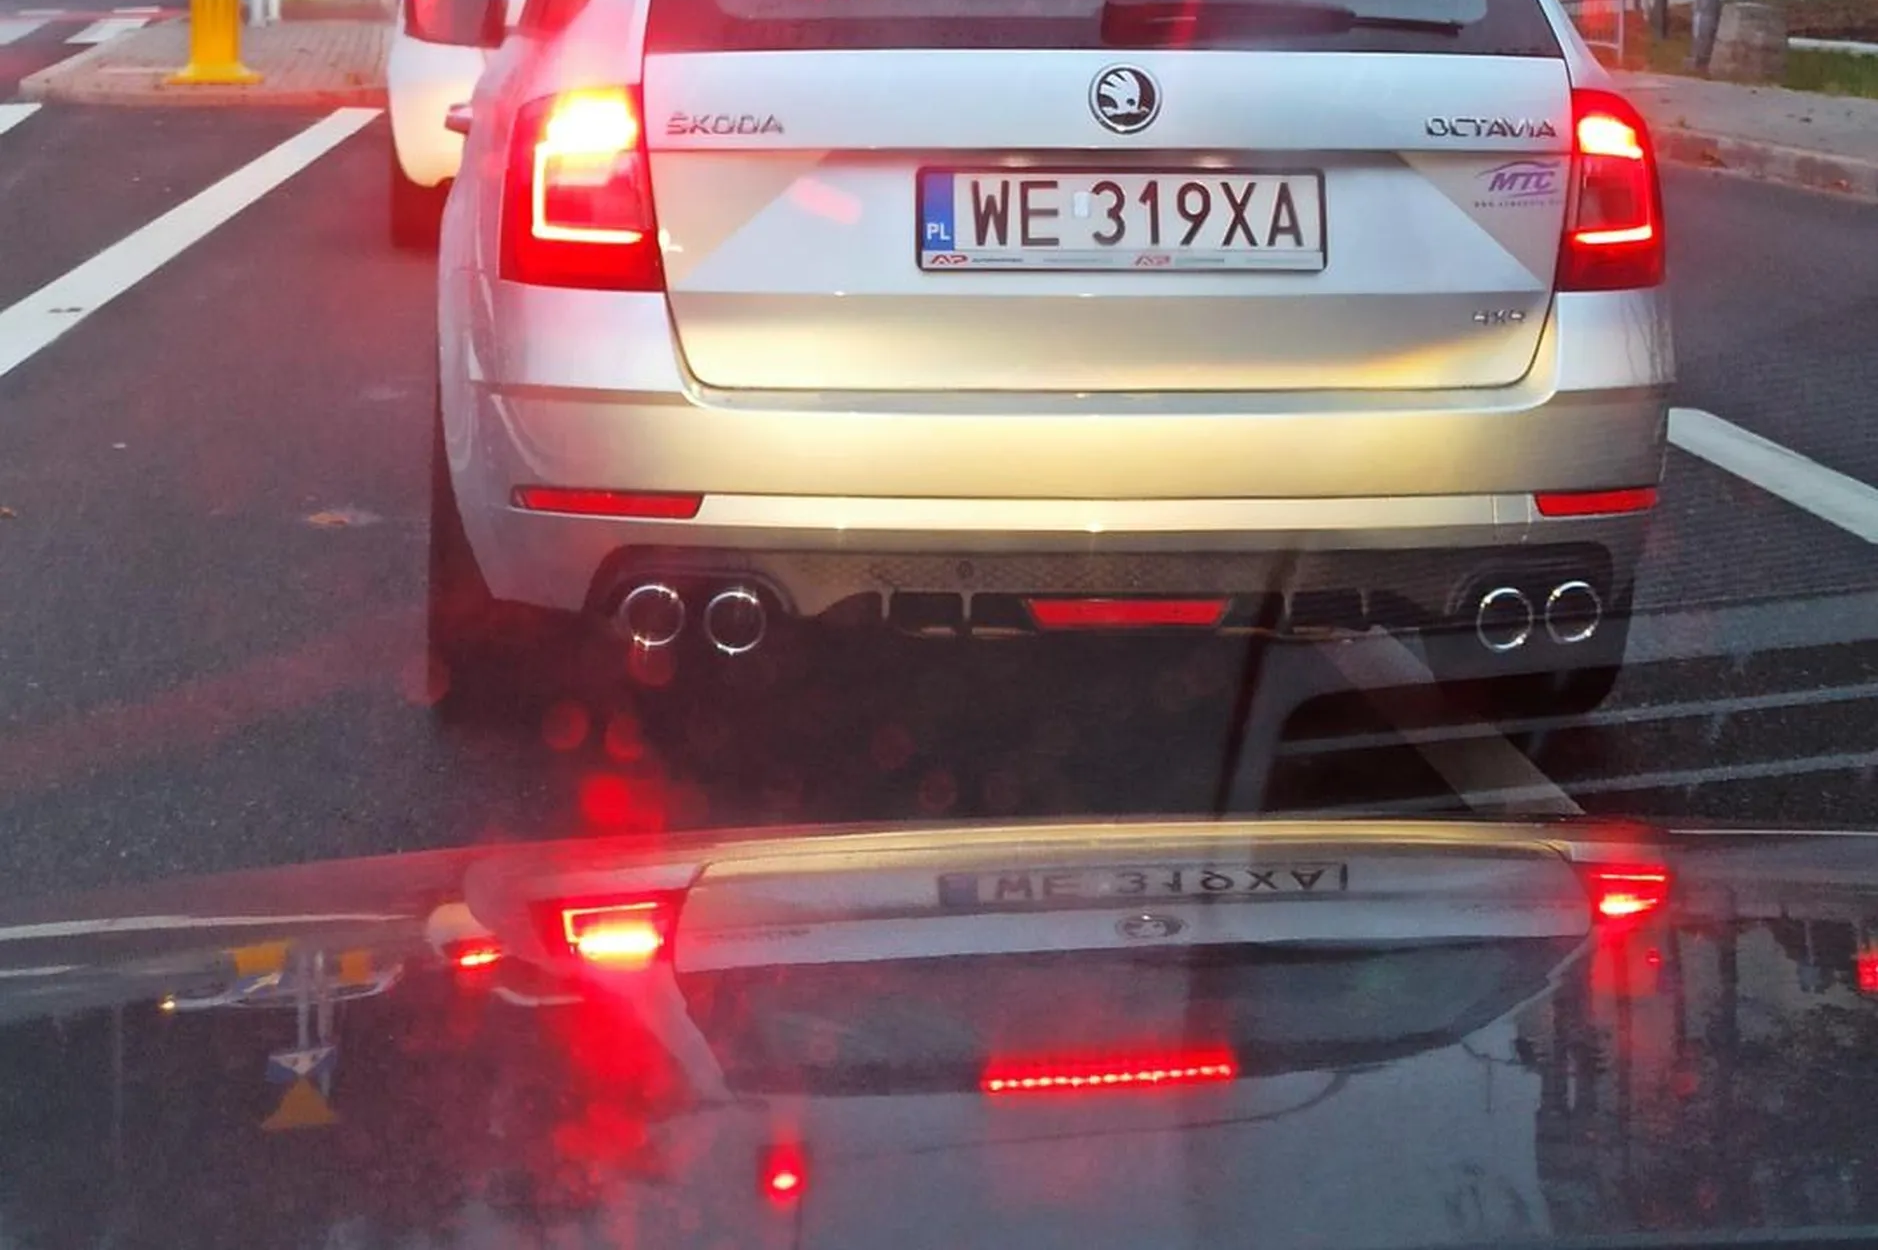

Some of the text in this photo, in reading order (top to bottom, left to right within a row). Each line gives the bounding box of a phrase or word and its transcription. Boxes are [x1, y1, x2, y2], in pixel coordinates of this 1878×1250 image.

[666, 110, 785, 135] ŠKODA
[1425, 117, 1557, 138] OCTAVIA
[1488, 171, 1555, 192] MTC
[970, 180, 1306, 247] WE 319XA
[926, 222, 951, 241] PL
